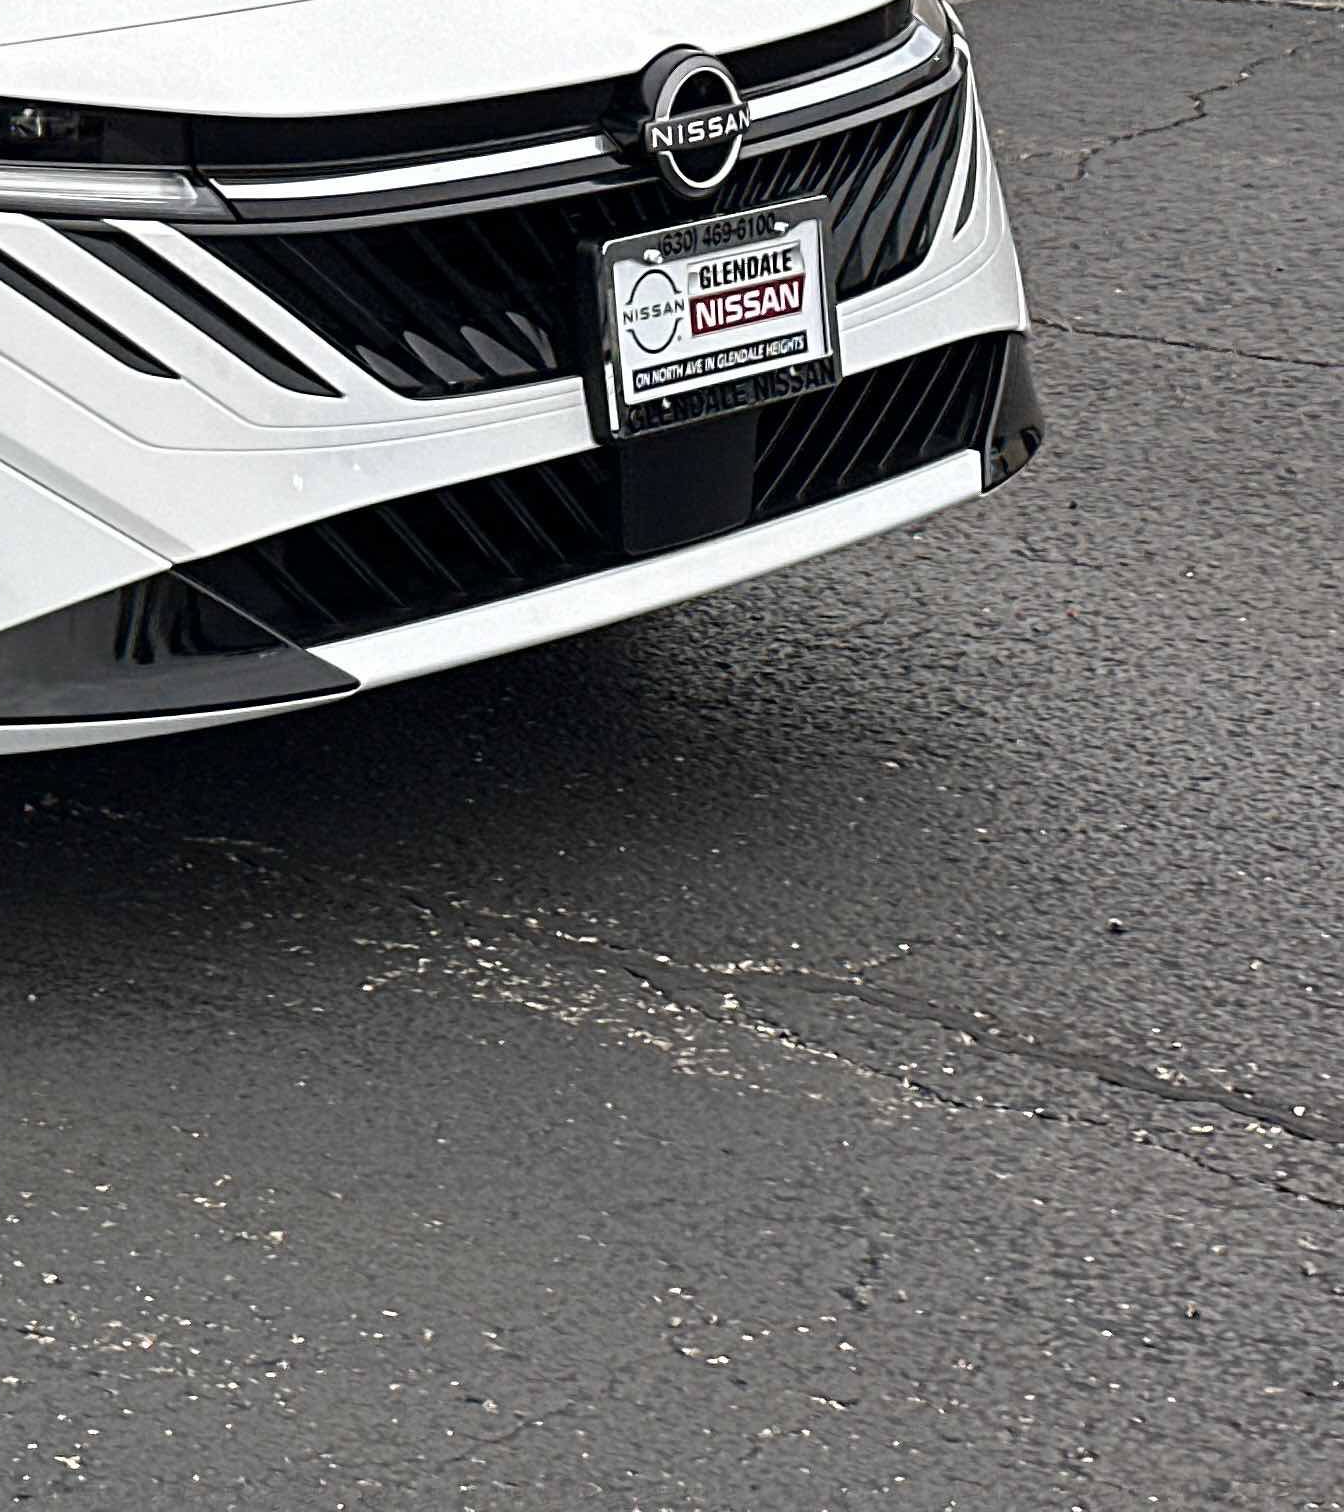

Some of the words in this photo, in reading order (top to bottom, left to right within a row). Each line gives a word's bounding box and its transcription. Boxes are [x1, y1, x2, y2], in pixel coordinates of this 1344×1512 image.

[651, 107, 750, 148] NISSAN
[657, 228, 698, 257] (630)
[702, 212, 777, 247] 469-6100
[699, 248, 793, 290] GLENDALE
[623, 298, 685, 325] NISSAN
[695, 281, 800, 331] NISSAN
[635, 371, 650, 389] ON
[652, 364, 684, 385] NORTH
[685, 358, 704, 378] AVE
[704, 355, 716, 371] IN
[717, 343, 765, 369] GLENDALE
[766, 335, 805, 357] HEIGHTS
[628, 380, 752, 432] GLENDALE
[753, 356, 837, 402] NISSAN
